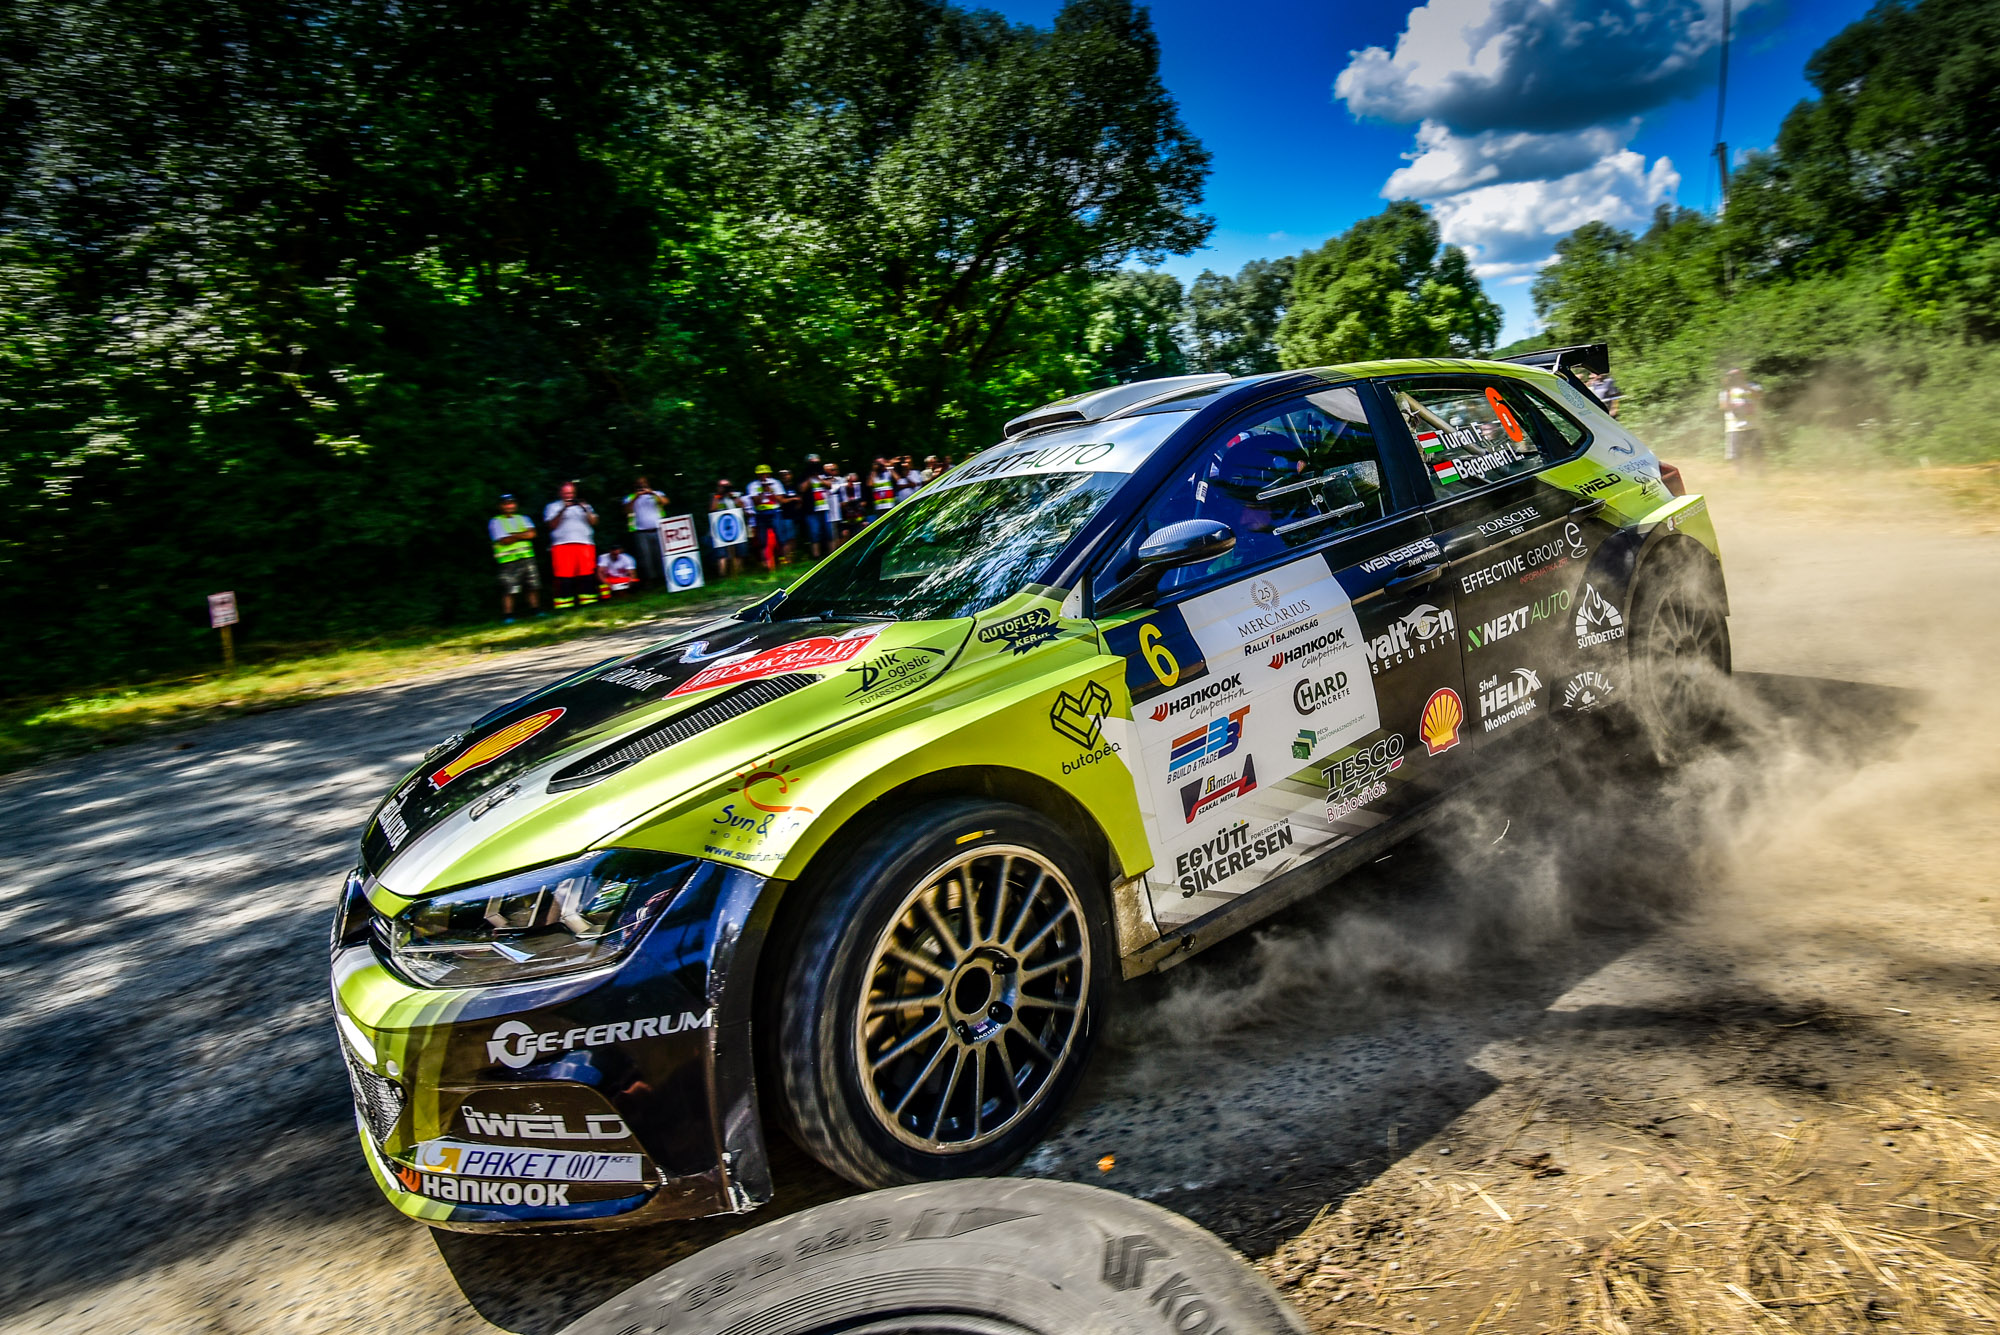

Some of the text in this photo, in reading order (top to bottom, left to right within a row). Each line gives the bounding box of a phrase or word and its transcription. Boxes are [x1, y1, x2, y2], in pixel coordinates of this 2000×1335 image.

[1485, 387, 1523, 442] 6
[1435, 422, 1488, 450] Turán F.
[947, 442, 1115, 485] NEXT AUTO
[1453, 442, 1525, 480] Bagaméri L.
[664, 526, 690, 543] RC
[1477, 506, 1538, 535] PORSCHE
[1510, 525, 1525, 535] PEST
[1360, 538, 1436, 574] WEINSBERG
[1461, 539, 1564, 594] EFFECTIVE GROUP
[1520, 562, 1558, 584] INFORMATIKA
[1258, 587, 1271, 600] 25
[981, 610, 1050, 641] AUTOFLEX
[1237, 599, 1311, 638] MERCARIUS
[1484, 590, 1570, 645] NEXT AUTO
[780, 639, 865, 666] RALLYE
[1015, 634, 1038, 647] KER
[1138, 623, 1180, 687] 6
[1244, 619, 1319, 656] RALLY 1 BAJNOKSÁG
[1372, 630, 1455, 674] SECURITY
[1577, 626, 1625, 649] SÜTÖDETECH
[859, 673, 928, 706] FUTÁRSZOLGÁLAT
[1479, 674, 1497, 693] Shell
[1479, 668, 1542, 717] HELIX
[1563, 671, 1614, 708] MULTIFILM
[1484, 698, 1536, 733] Motorolajok
[1173, 764, 1192, 782] BUILD
[1198, 751, 1218, 769] TRADE
[1322, 733, 1404, 791] TESCO
[1220, 791, 1237, 804] METAL
[1326, 780, 1387, 823] Biztosítás
[384, 810, 411, 852] ULTRA
[713, 804, 756, 831] Sun
[756, 814, 775, 839] &
[1176, 821, 1250, 877] EGYÜTT
[1251, 827, 1273, 840] POWERED
[516, 1007, 713, 1055] FE-FERRUM
[462, 1150, 633, 1179] PAKET 007 KFT.
[795, 1218, 892, 1263] 22.5
[1149, 1271, 1230, 1335] KO
